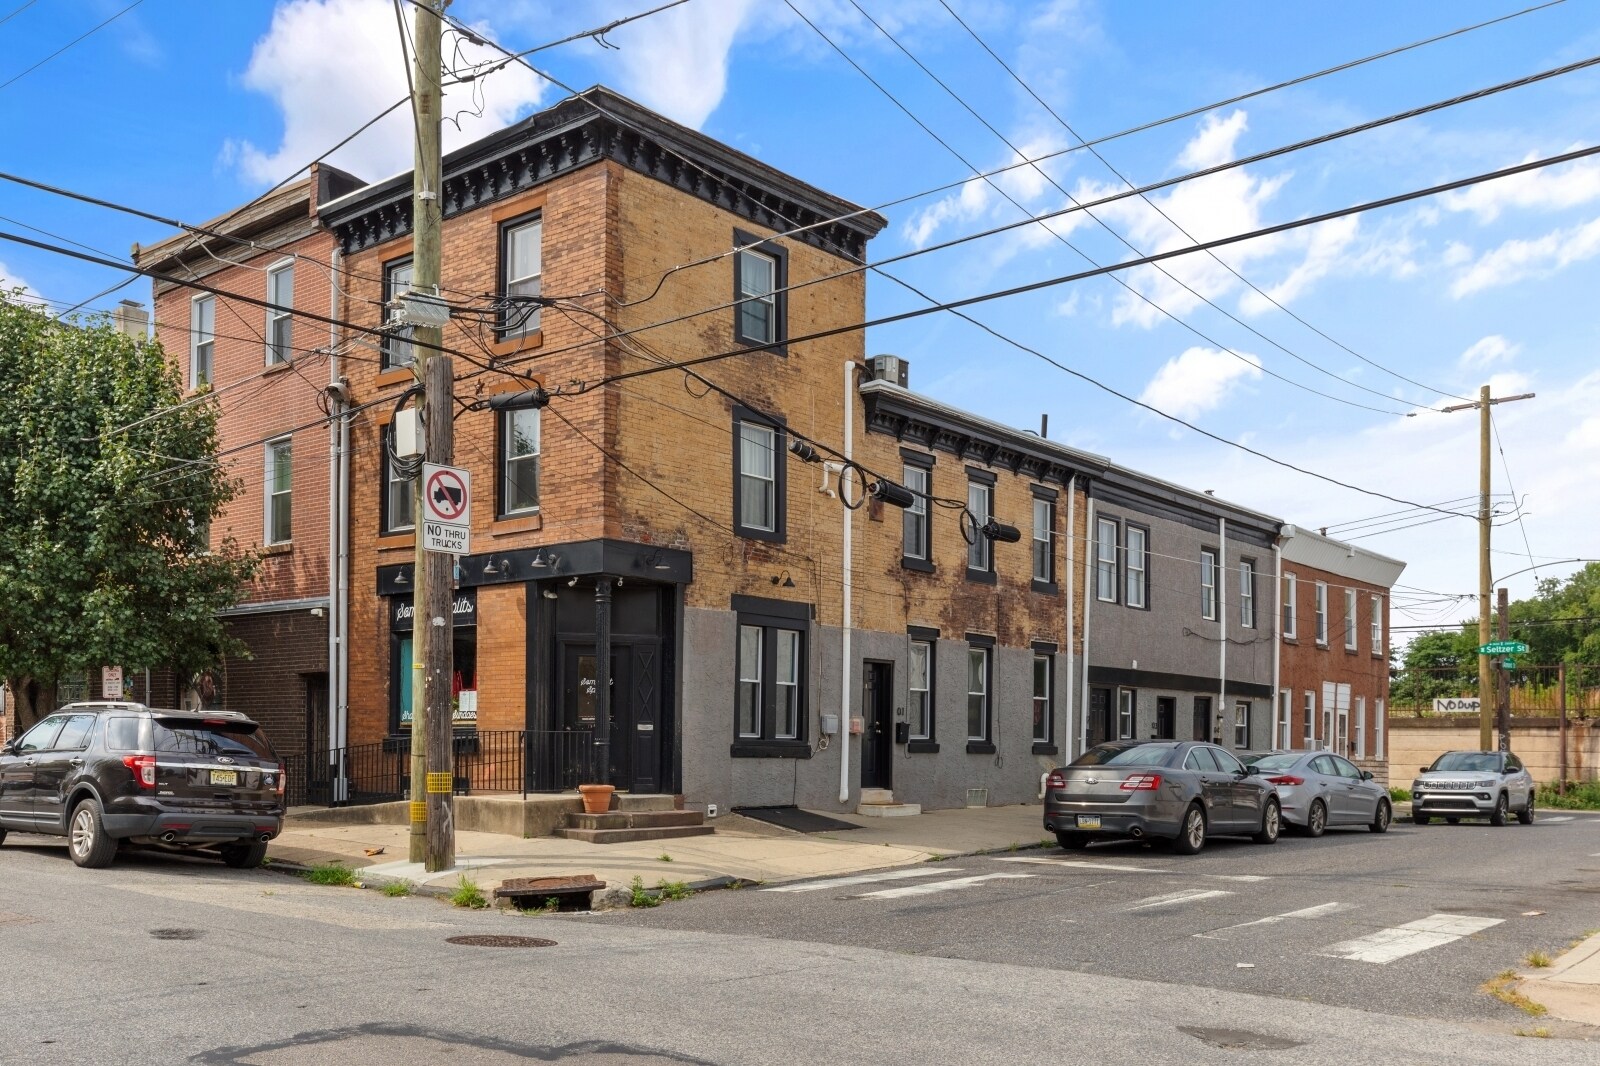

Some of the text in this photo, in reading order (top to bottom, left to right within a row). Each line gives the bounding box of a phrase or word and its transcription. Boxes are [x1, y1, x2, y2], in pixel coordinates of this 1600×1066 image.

[427, 524, 466, 540] NO THRU
[431, 537, 463, 550] TRUCKS
[1486, 645, 1514, 653] Seltzer
[1437, 699, 1456, 711] NO
